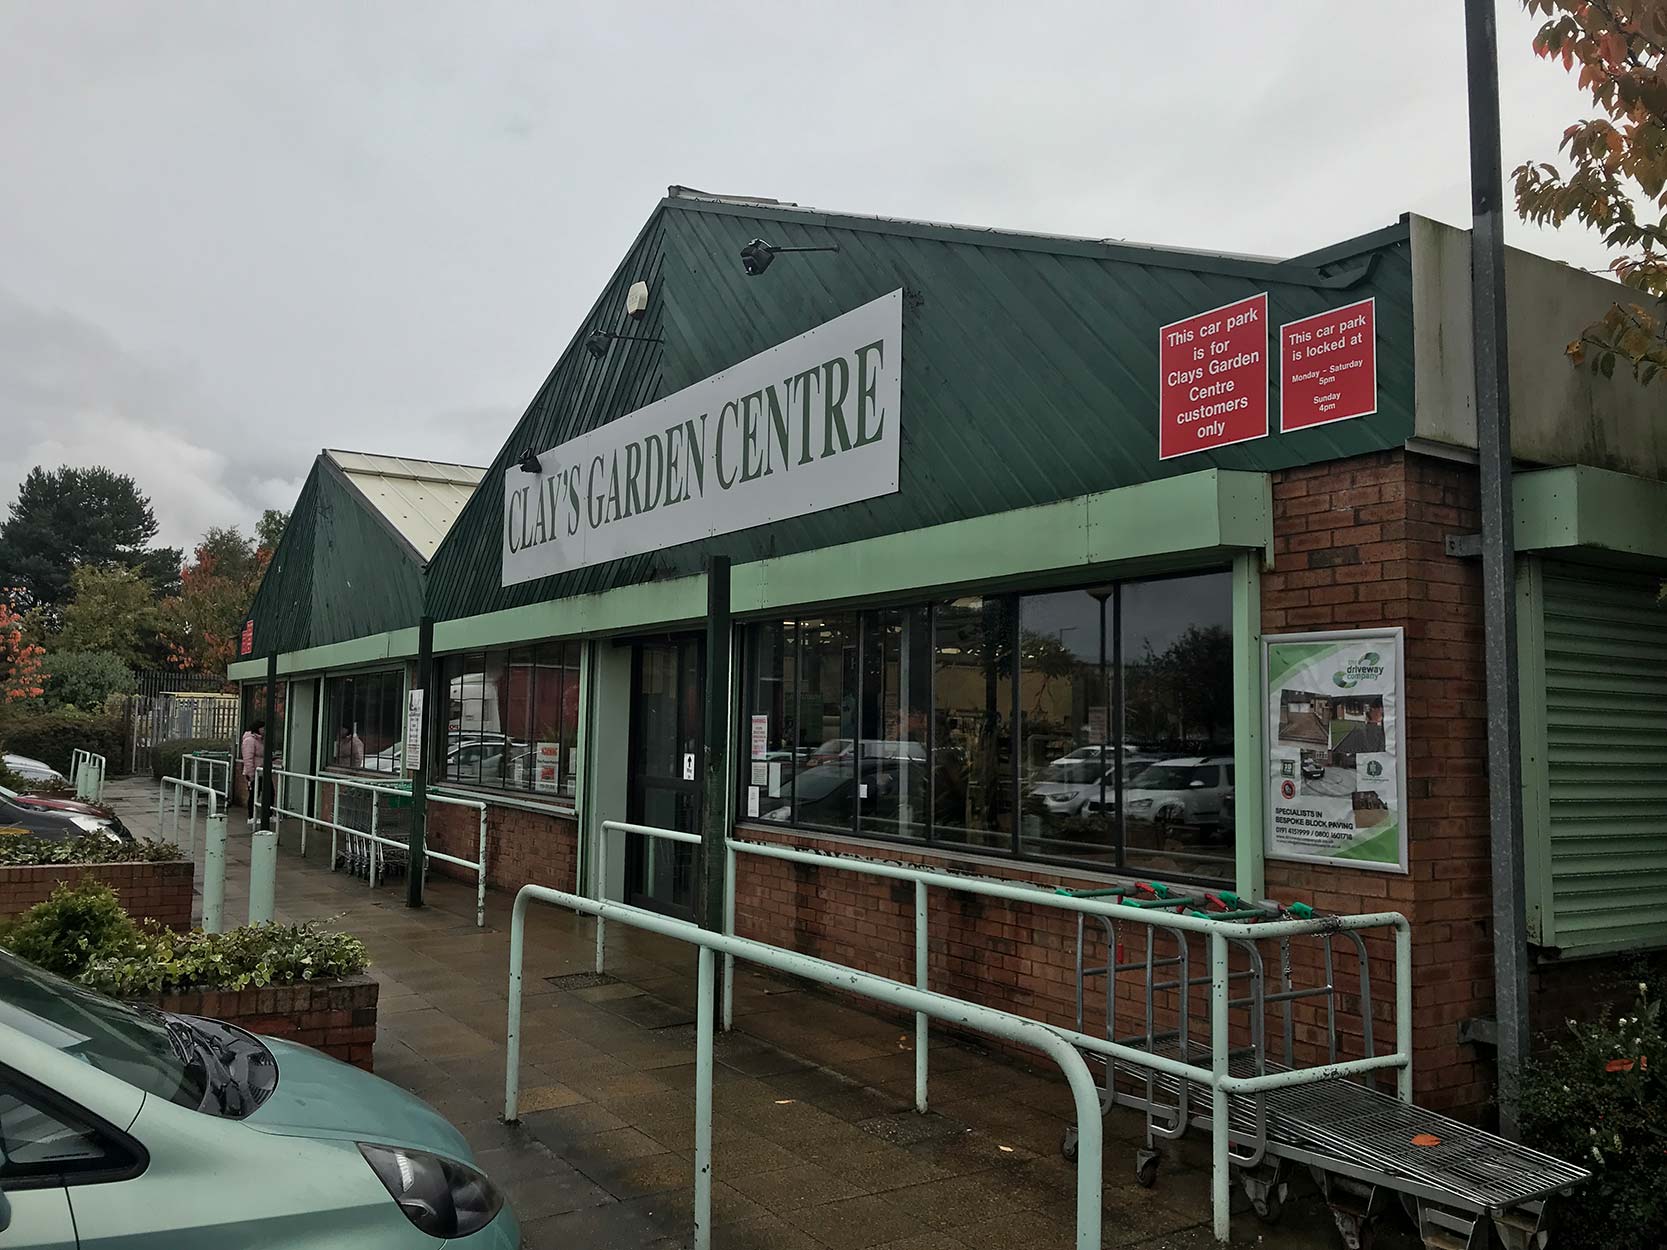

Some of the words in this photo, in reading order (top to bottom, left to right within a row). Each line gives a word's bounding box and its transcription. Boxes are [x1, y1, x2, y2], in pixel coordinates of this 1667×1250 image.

[1167, 330, 1194, 347] This
[1200, 321, 1221, 338] car
[1227, 308, 1258, 332] park
[1289, 331, 1312, 346] This
[1316, 326, 1335, 339] car
[1339, 315, 1366, 333] park
[1193, 348, 1204, 361] is
[1210, 339, 1230, 356] for
[1292, 350, 1302, 361] is
[1306, 339, 1346, 357] locked
[1350, 332, 1363, 344] at
[1167, 365, 1203, 387] Clays
[1208, 351, 1259, 375] Garden
[1291, 369, 1320, 383] Monday
[1329, 359, 1363, 374] Saturday
[1189, 379, 1235, 401] Centre
[1318, 375, 1336, 387] 5pm
[1313, 391, 1341, 404] Sunday
[1318, 402, 1336, 413] 4pm
[1176, 396, 1248, 424] customers
[1197, 421, 1225, 439] only
[507, 463, 581, 555] CLAY'S
[587, 413, 709, 529] GARDEN
[715, 339, 885, 490] CENTRE
[1346, 665, 1384, 675] driveway
[1346, 673, 1378, 681] company
[1275, 807, 1315, 818] SPECIALISTS
[1275, 816, 1304, 826] BESPOKE
[1305, 819, 1328, 828] BLOCK
[1328, 821, 1354, 830] PAVING
[1314, 830, 1330, 838] 0800
